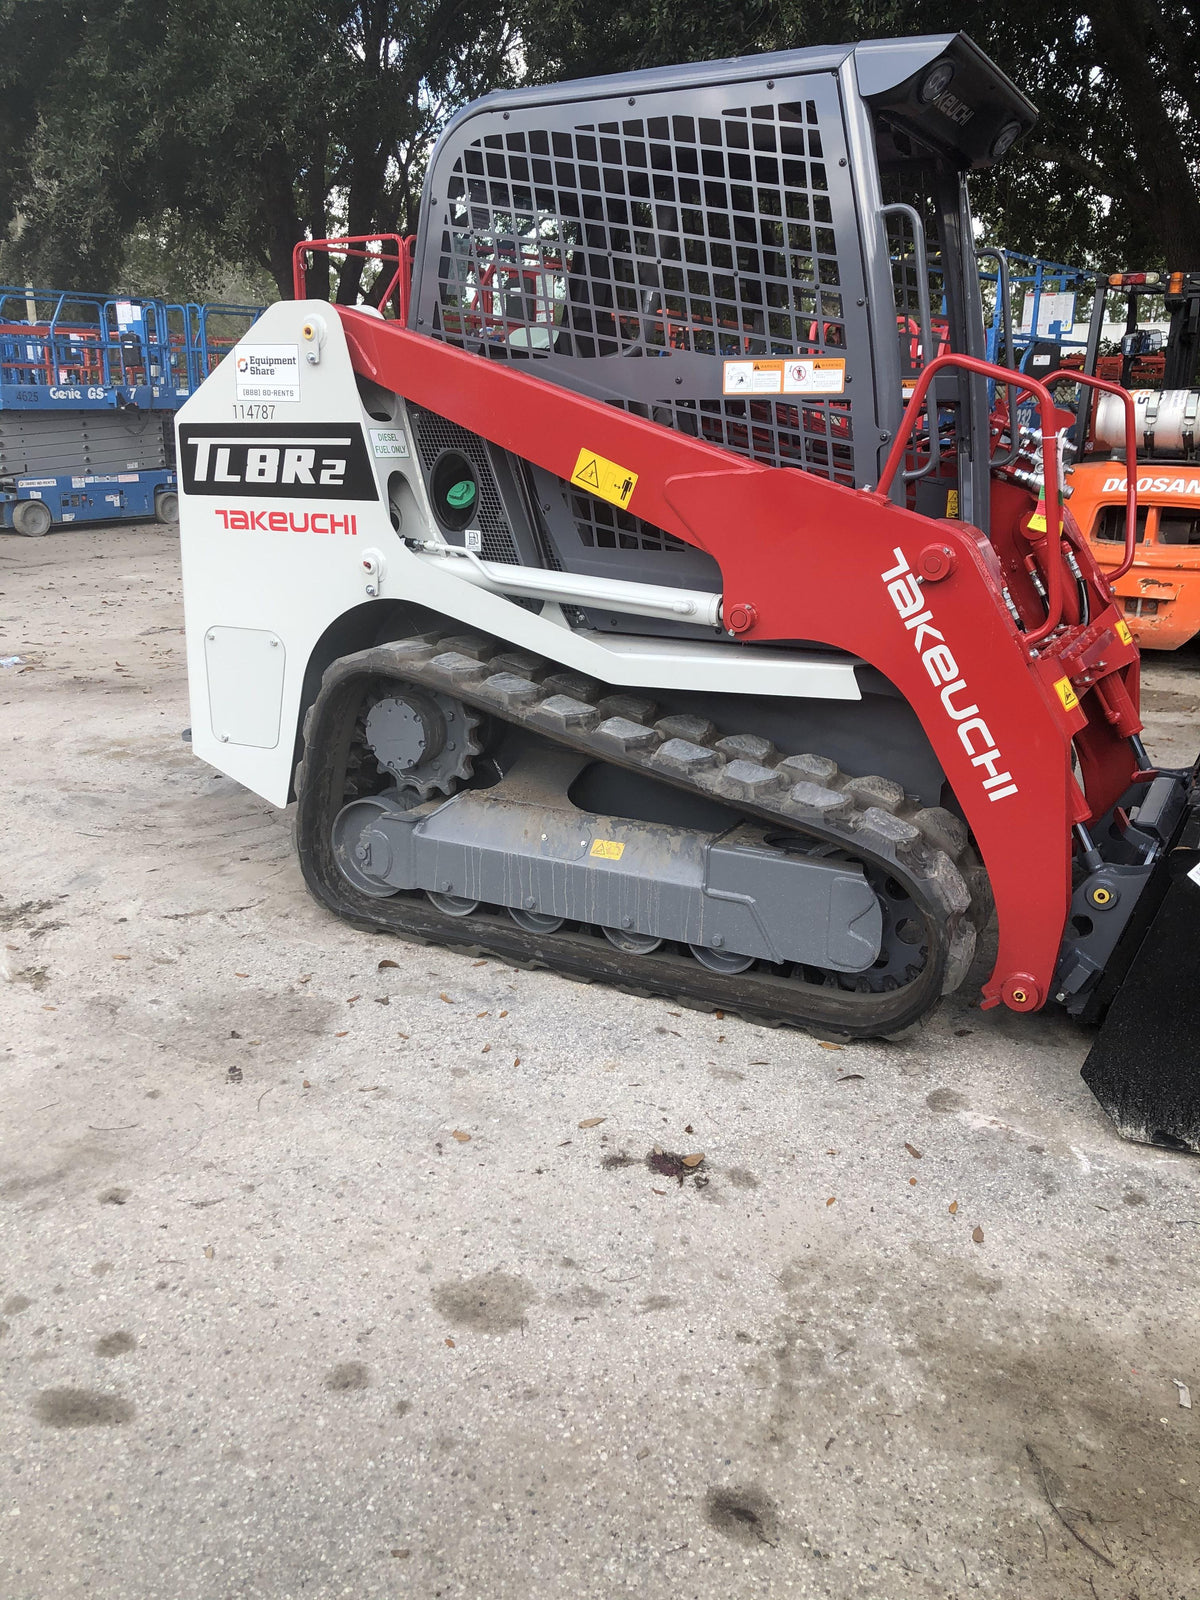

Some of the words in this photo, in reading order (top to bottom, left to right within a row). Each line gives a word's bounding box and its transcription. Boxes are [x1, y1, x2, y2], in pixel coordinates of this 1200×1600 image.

[249, 356, 297, 367] Equipment
[250, 367, 275, 375] Share
[16, 391, 39, 402] 4625
[50, 387, 83, 399] Genie
[233, 405, 276, 420] 114787
[377, 433, 399, 442] DIESEL
[375, 446, 391, 454] FUEL
[391, 445, 406, 454] ONLY
